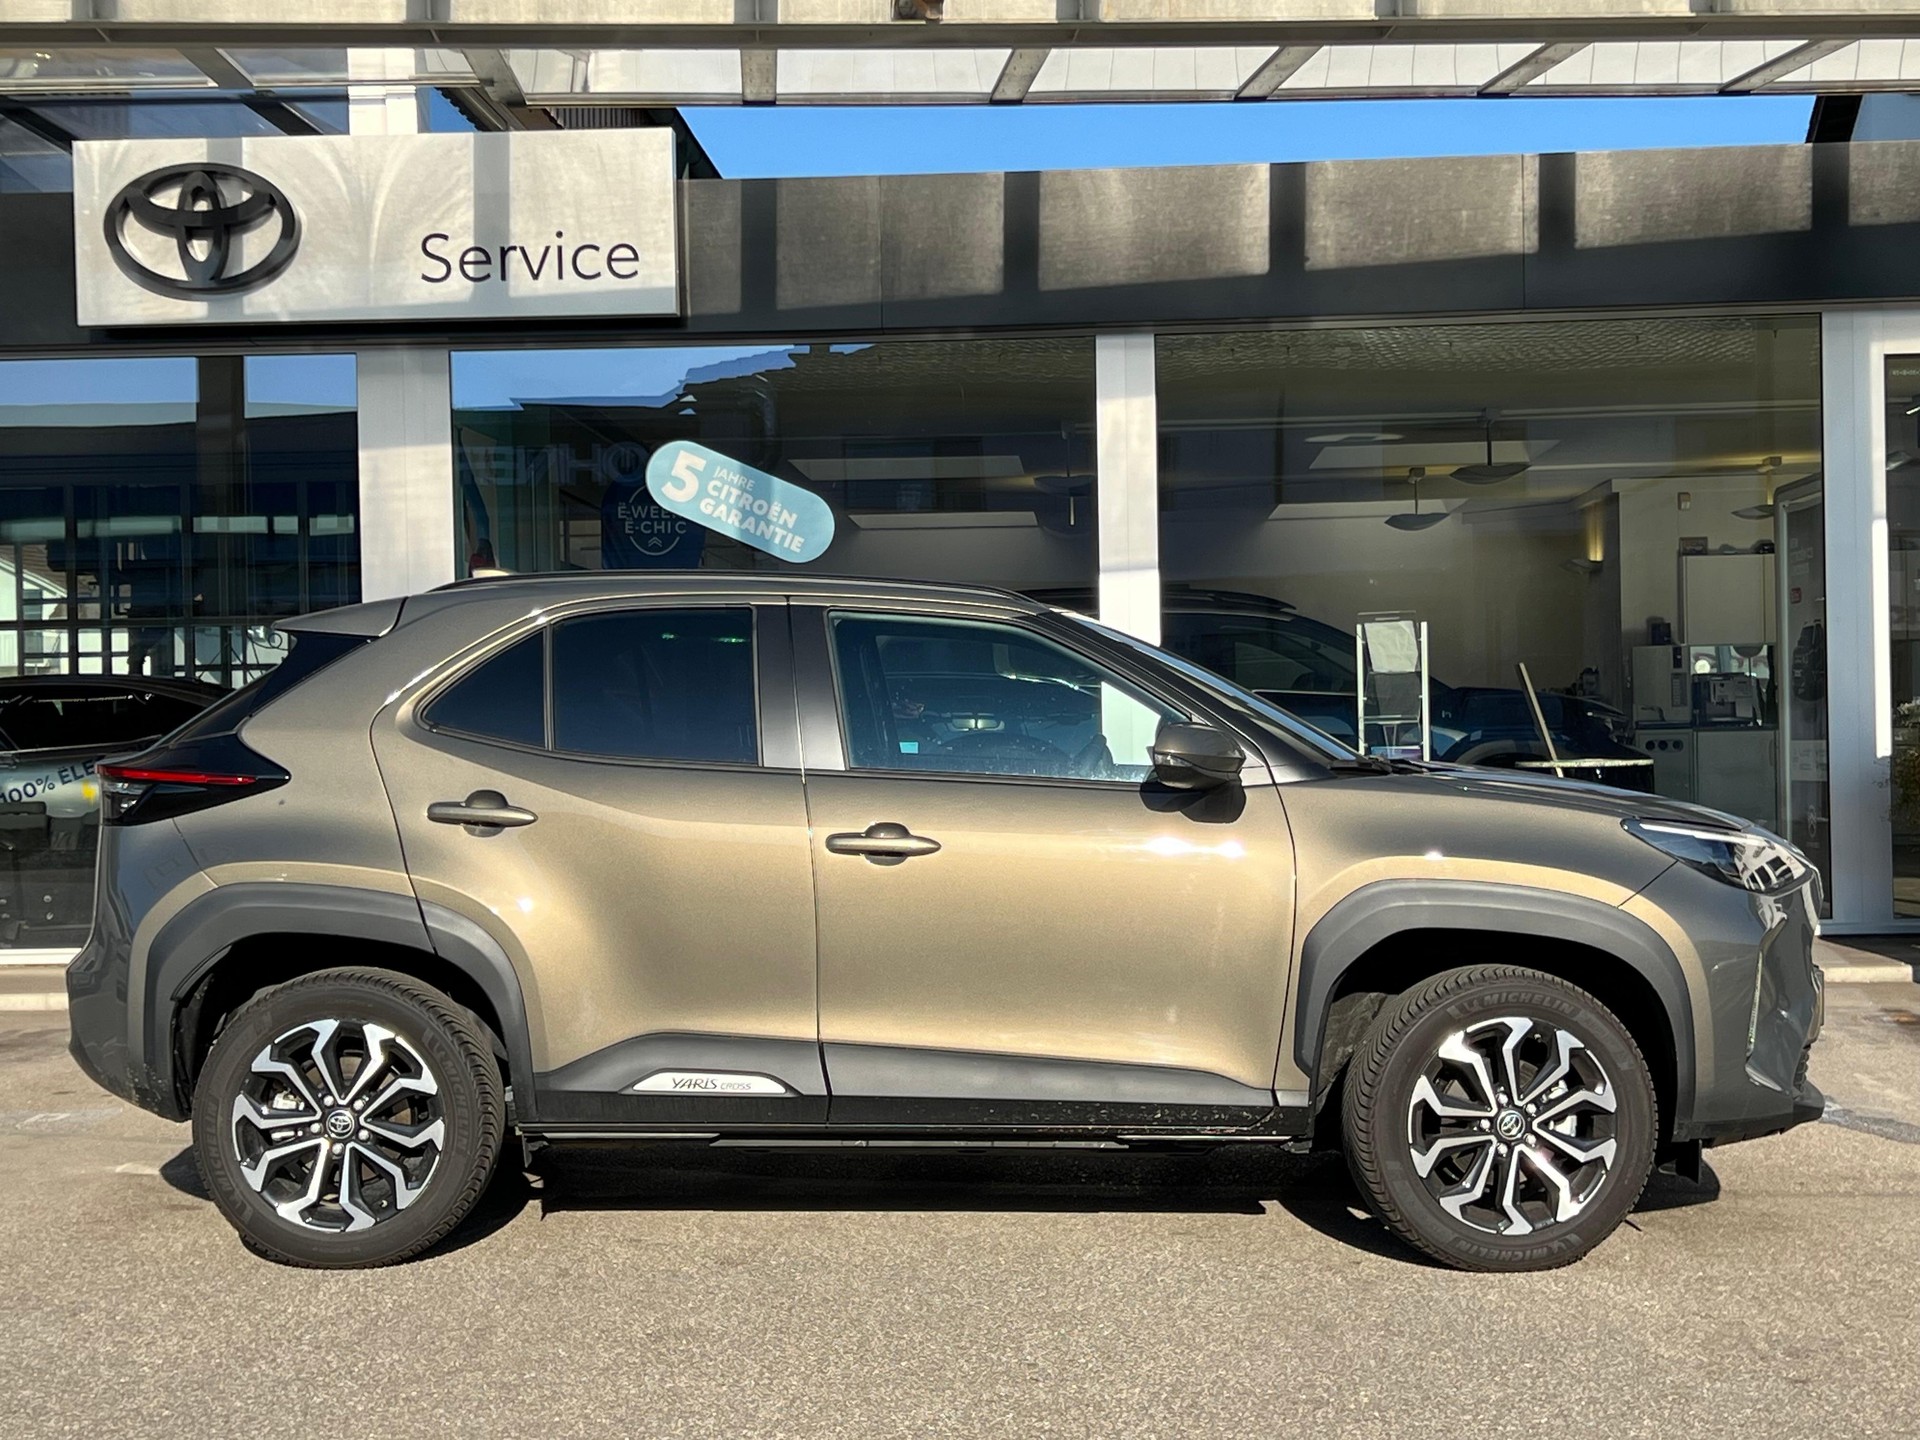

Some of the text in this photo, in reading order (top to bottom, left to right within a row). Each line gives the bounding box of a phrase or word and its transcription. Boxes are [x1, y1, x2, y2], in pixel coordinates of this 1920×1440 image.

[421, 230, 640, 283] Service
[661, 449, 707, 503] 5
[713, 465, 756, 491] JAHRE
[617, 501, 677, 519] Ë-WEE
[706, 480, 799, 529] CITROËN
[699, 497, 806, 554] GARANTIE
[57, 755, 105, 785] ËLE
[1485, 992, 1574, 1016] MICHELIN
[672, 1077, 752, 1091] YARIS CROSS
[1452, 1238, 1554, 1262] MICHELIN
